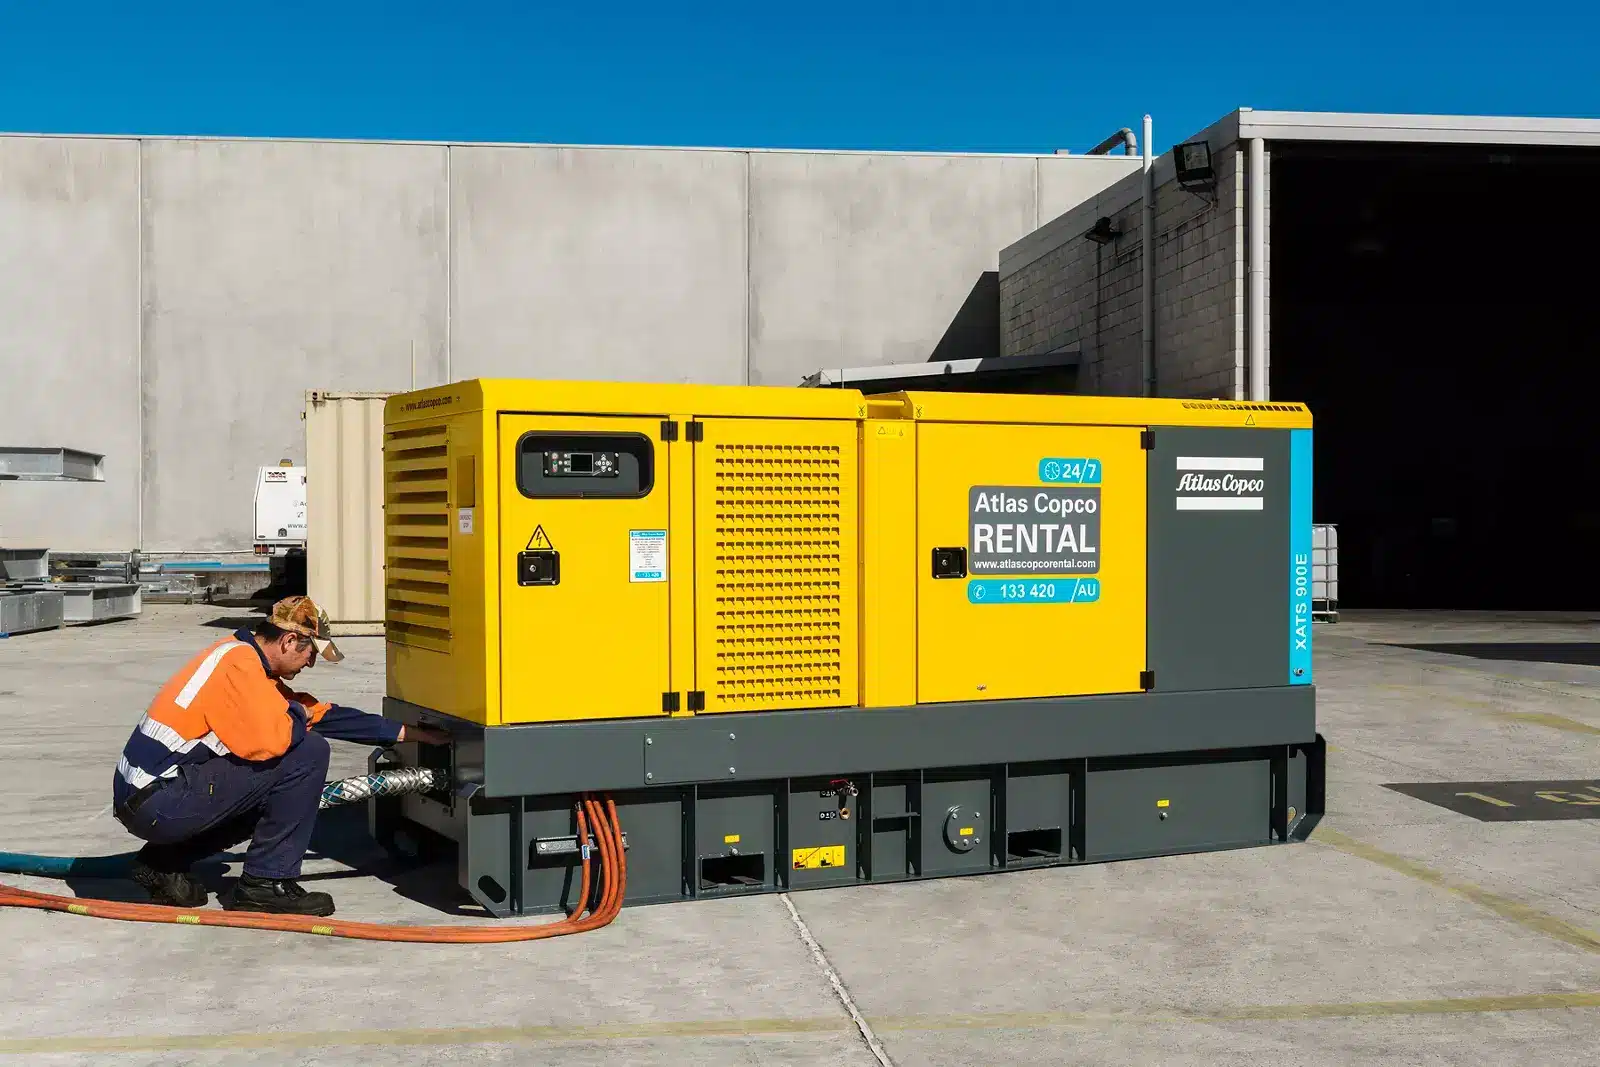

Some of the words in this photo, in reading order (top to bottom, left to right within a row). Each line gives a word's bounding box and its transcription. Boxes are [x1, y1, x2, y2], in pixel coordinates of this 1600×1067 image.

[1062, 458, 1097, 484] 24/7
[1176, 473, 1221, 491] Atlas
[1222, 473, 1264, 495] Copco
[974, 492, 1028, 513] Atlas
[1034, 493, 1097, 518] Copco
[974, 523, 1096, 553] RENTAL
[974, 558, 1096, 571] www.atlascopcorental.com
[1295, 554, 1308, 597] 900E
[1000, 584, 1026, 598] 133
[1029, 583, 1055, 598] 420
[1295, 602, 1307, 650] XATS
